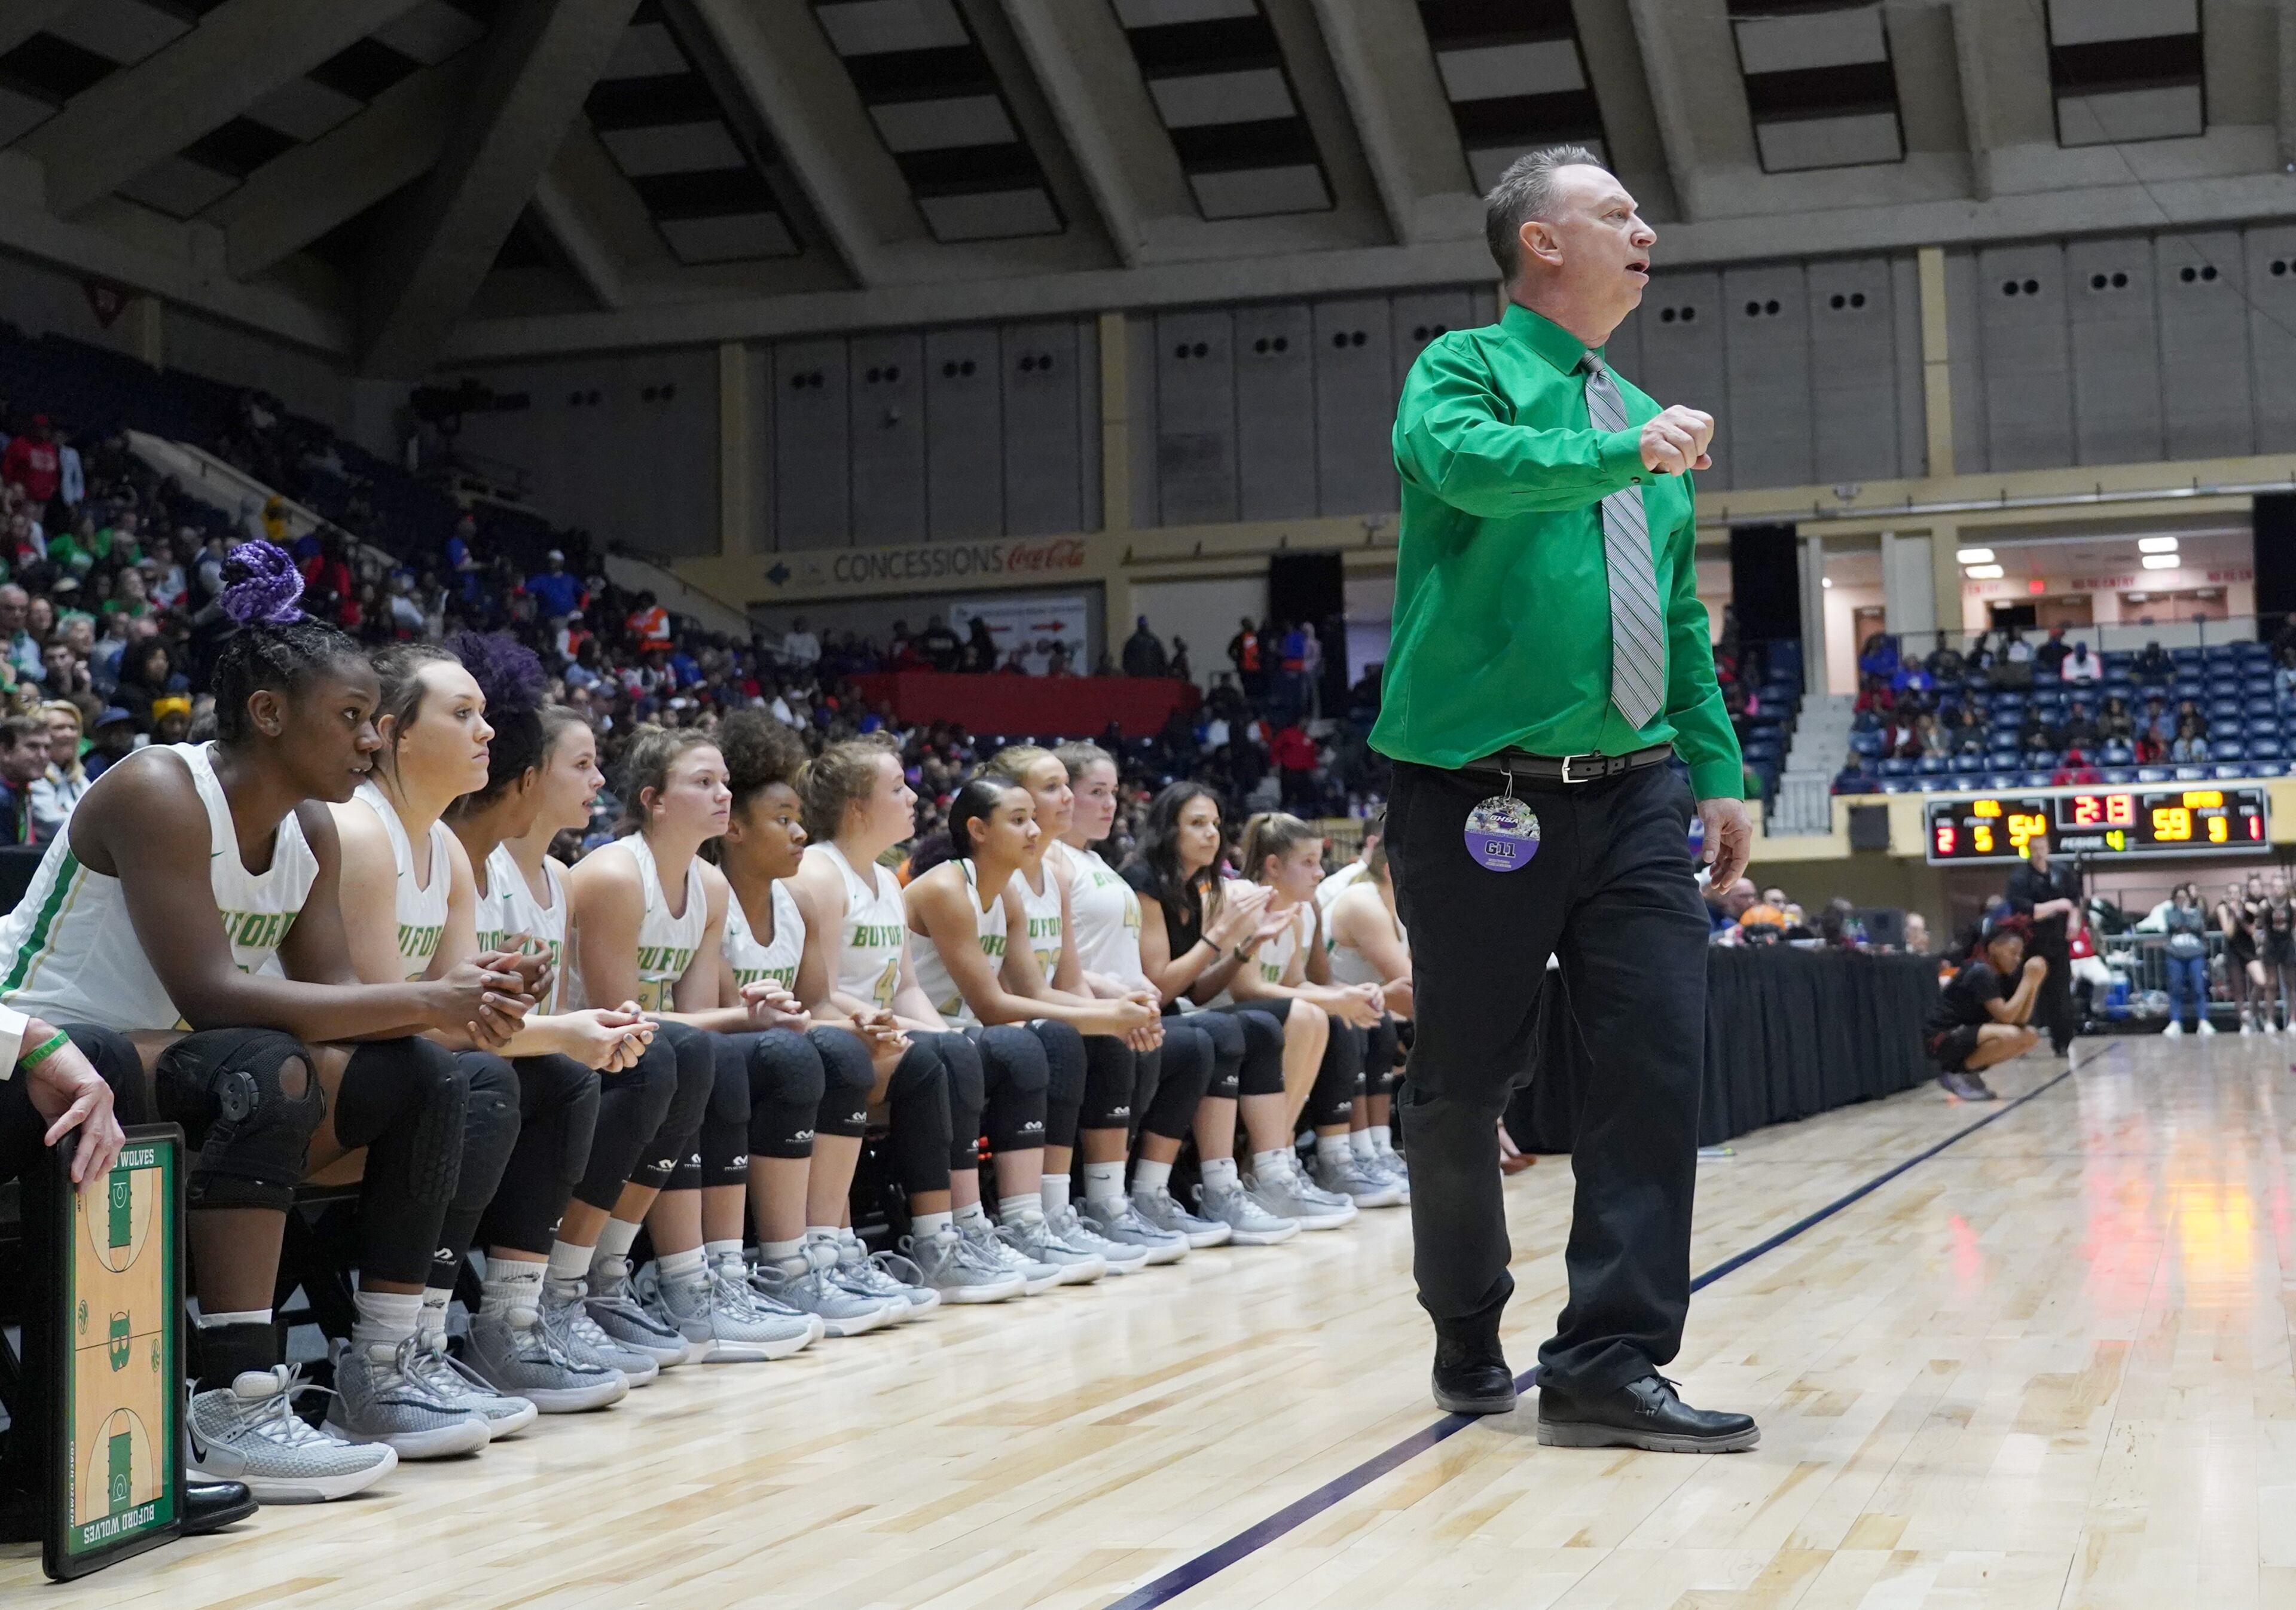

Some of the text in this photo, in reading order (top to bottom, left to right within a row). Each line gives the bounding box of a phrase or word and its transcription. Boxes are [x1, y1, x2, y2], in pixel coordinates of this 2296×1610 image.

[834, 545, 1003, 582] CONCESSIONS
[1489, 814, 1519, 824] GHSA
[2152, 808, 2191, 841] 59
[2250, 815, 2260, 841] 1
[1485, 840, 1516, 858] G11
[1937, 827, 1955, 853] 2
[1974, 826, 1993, 852] 5
[2106, 830, 2125, 851] 4
[120, 1148, 154, 1168] WOLVES
[84, 1504, 155, 1544] BUFORD WOLVES
